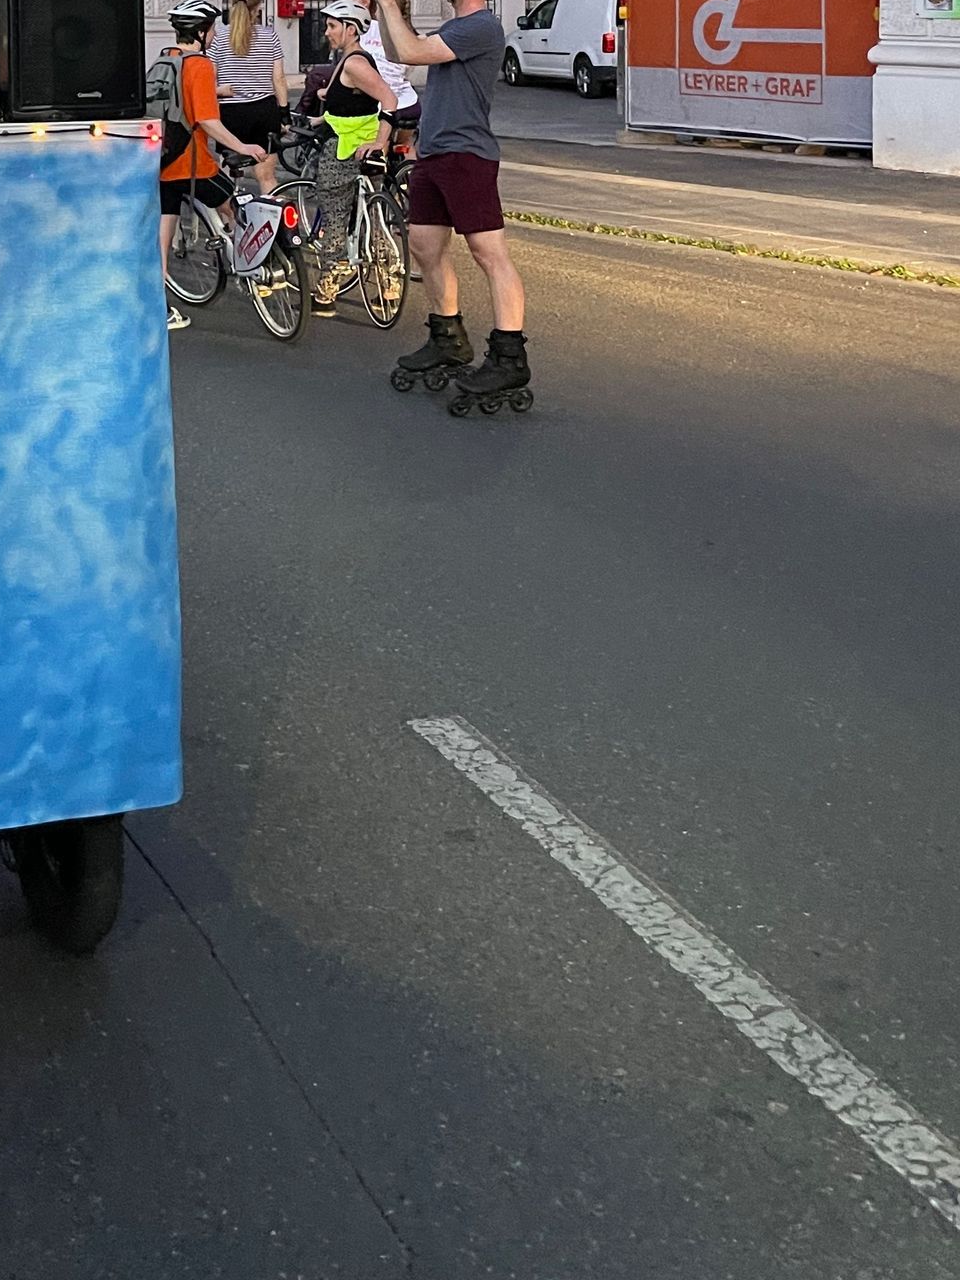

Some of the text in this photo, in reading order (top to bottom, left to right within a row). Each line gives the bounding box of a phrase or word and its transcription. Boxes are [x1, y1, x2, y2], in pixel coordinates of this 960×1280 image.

[684, 73, 816, 98] LEYRER + GRAF
